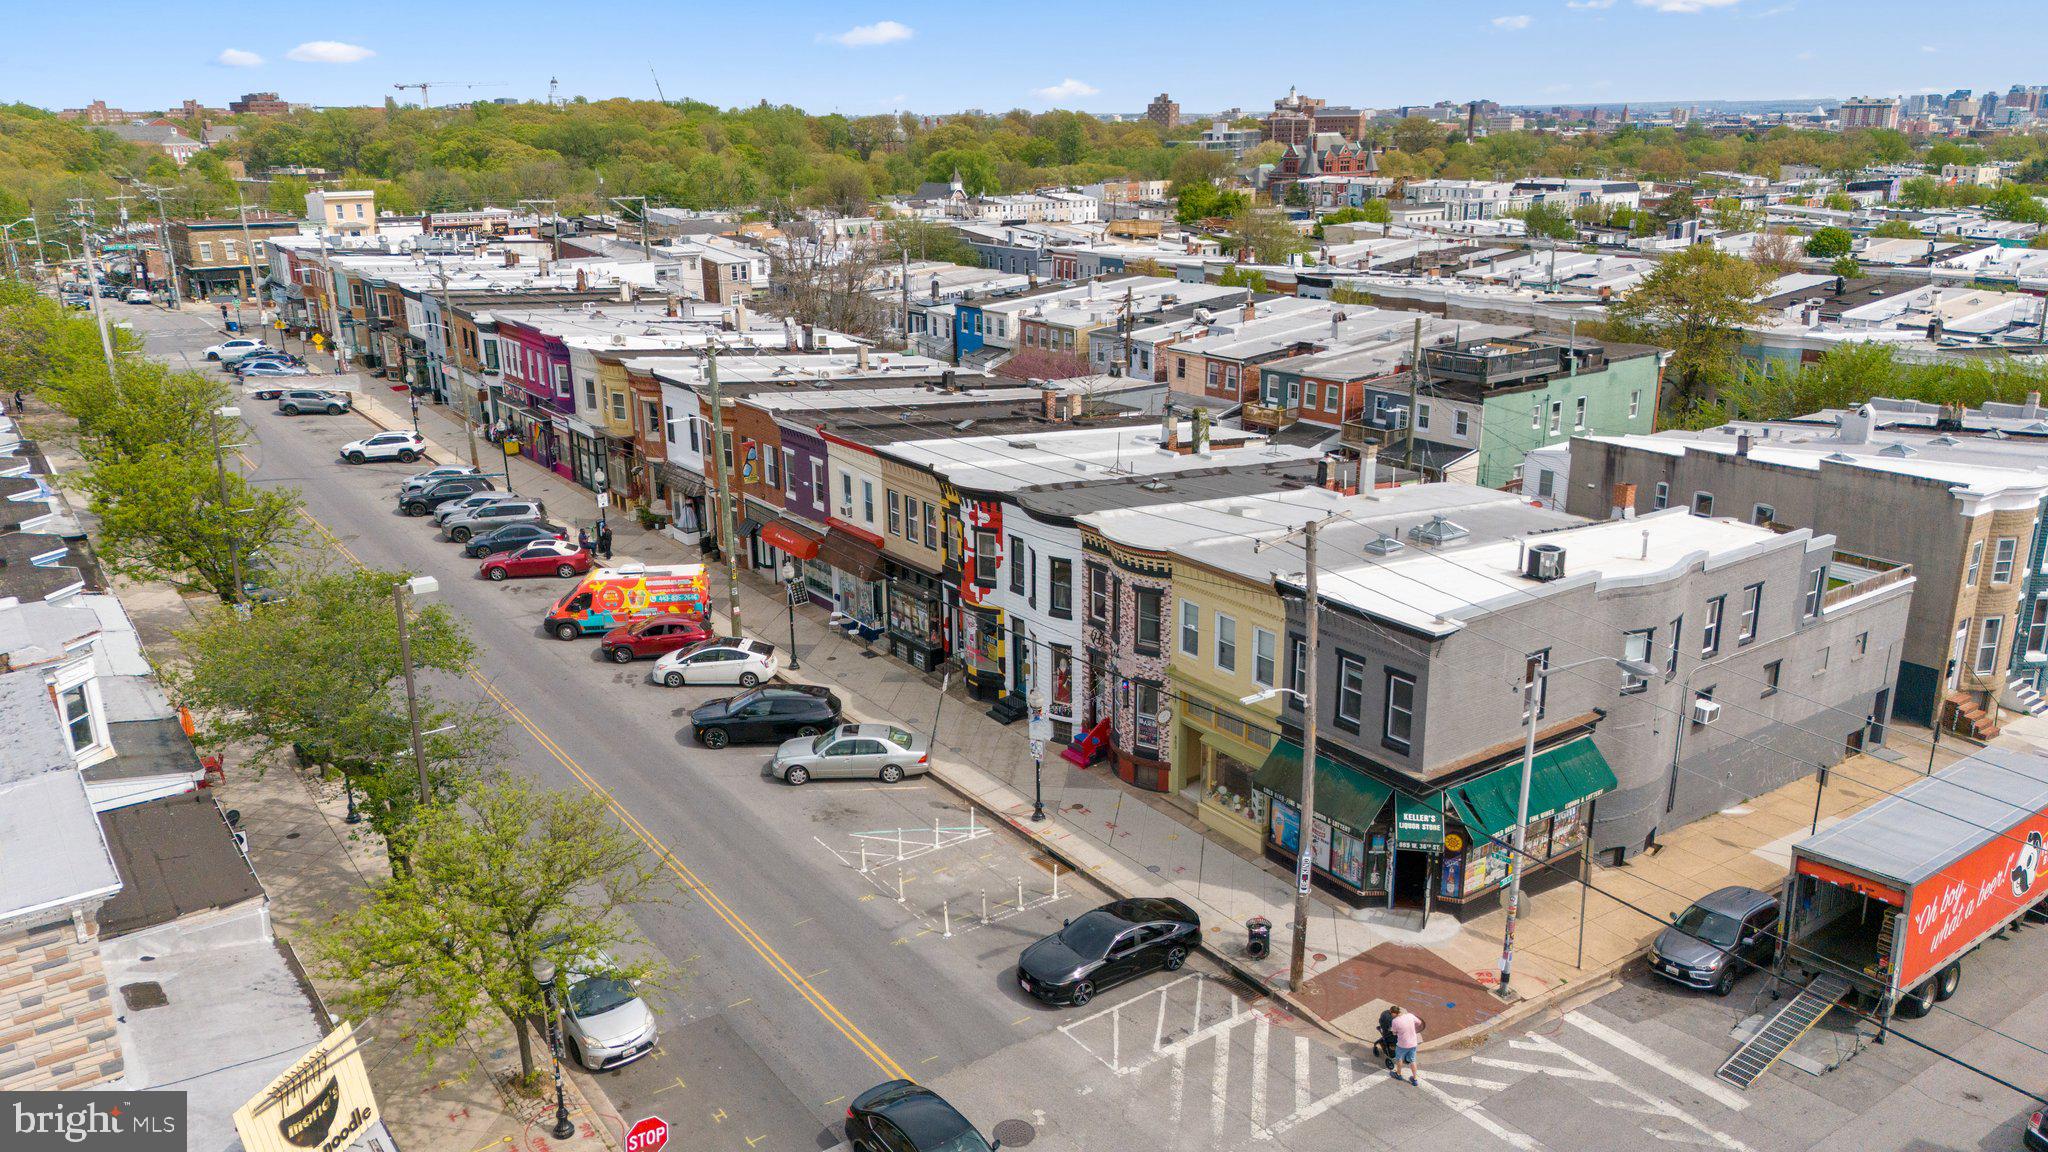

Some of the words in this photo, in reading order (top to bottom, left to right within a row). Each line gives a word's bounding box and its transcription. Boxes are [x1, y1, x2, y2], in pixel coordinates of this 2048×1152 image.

[1403, 813, 1436, 823] KELLER'S
[1504, 823, 1517, 834] BEER
[1529, 815, 1540, 824] FINE
[1540, 808, 1555, 820] WINES
[1565, 798, 1580, 810] LIQUOR
[1585, 788, 1604, 802] LOTTERY
[1332, 819, 1351, 833] LOTTERY
[1399, 822, 1420, 831] LIQUOR
[1930, 902, 1964, 953] what
[1964, 898, 1975, 920] a
[323, 1107, 372, 1152] noodle
[628, 1126, 665, 1151] STOP
